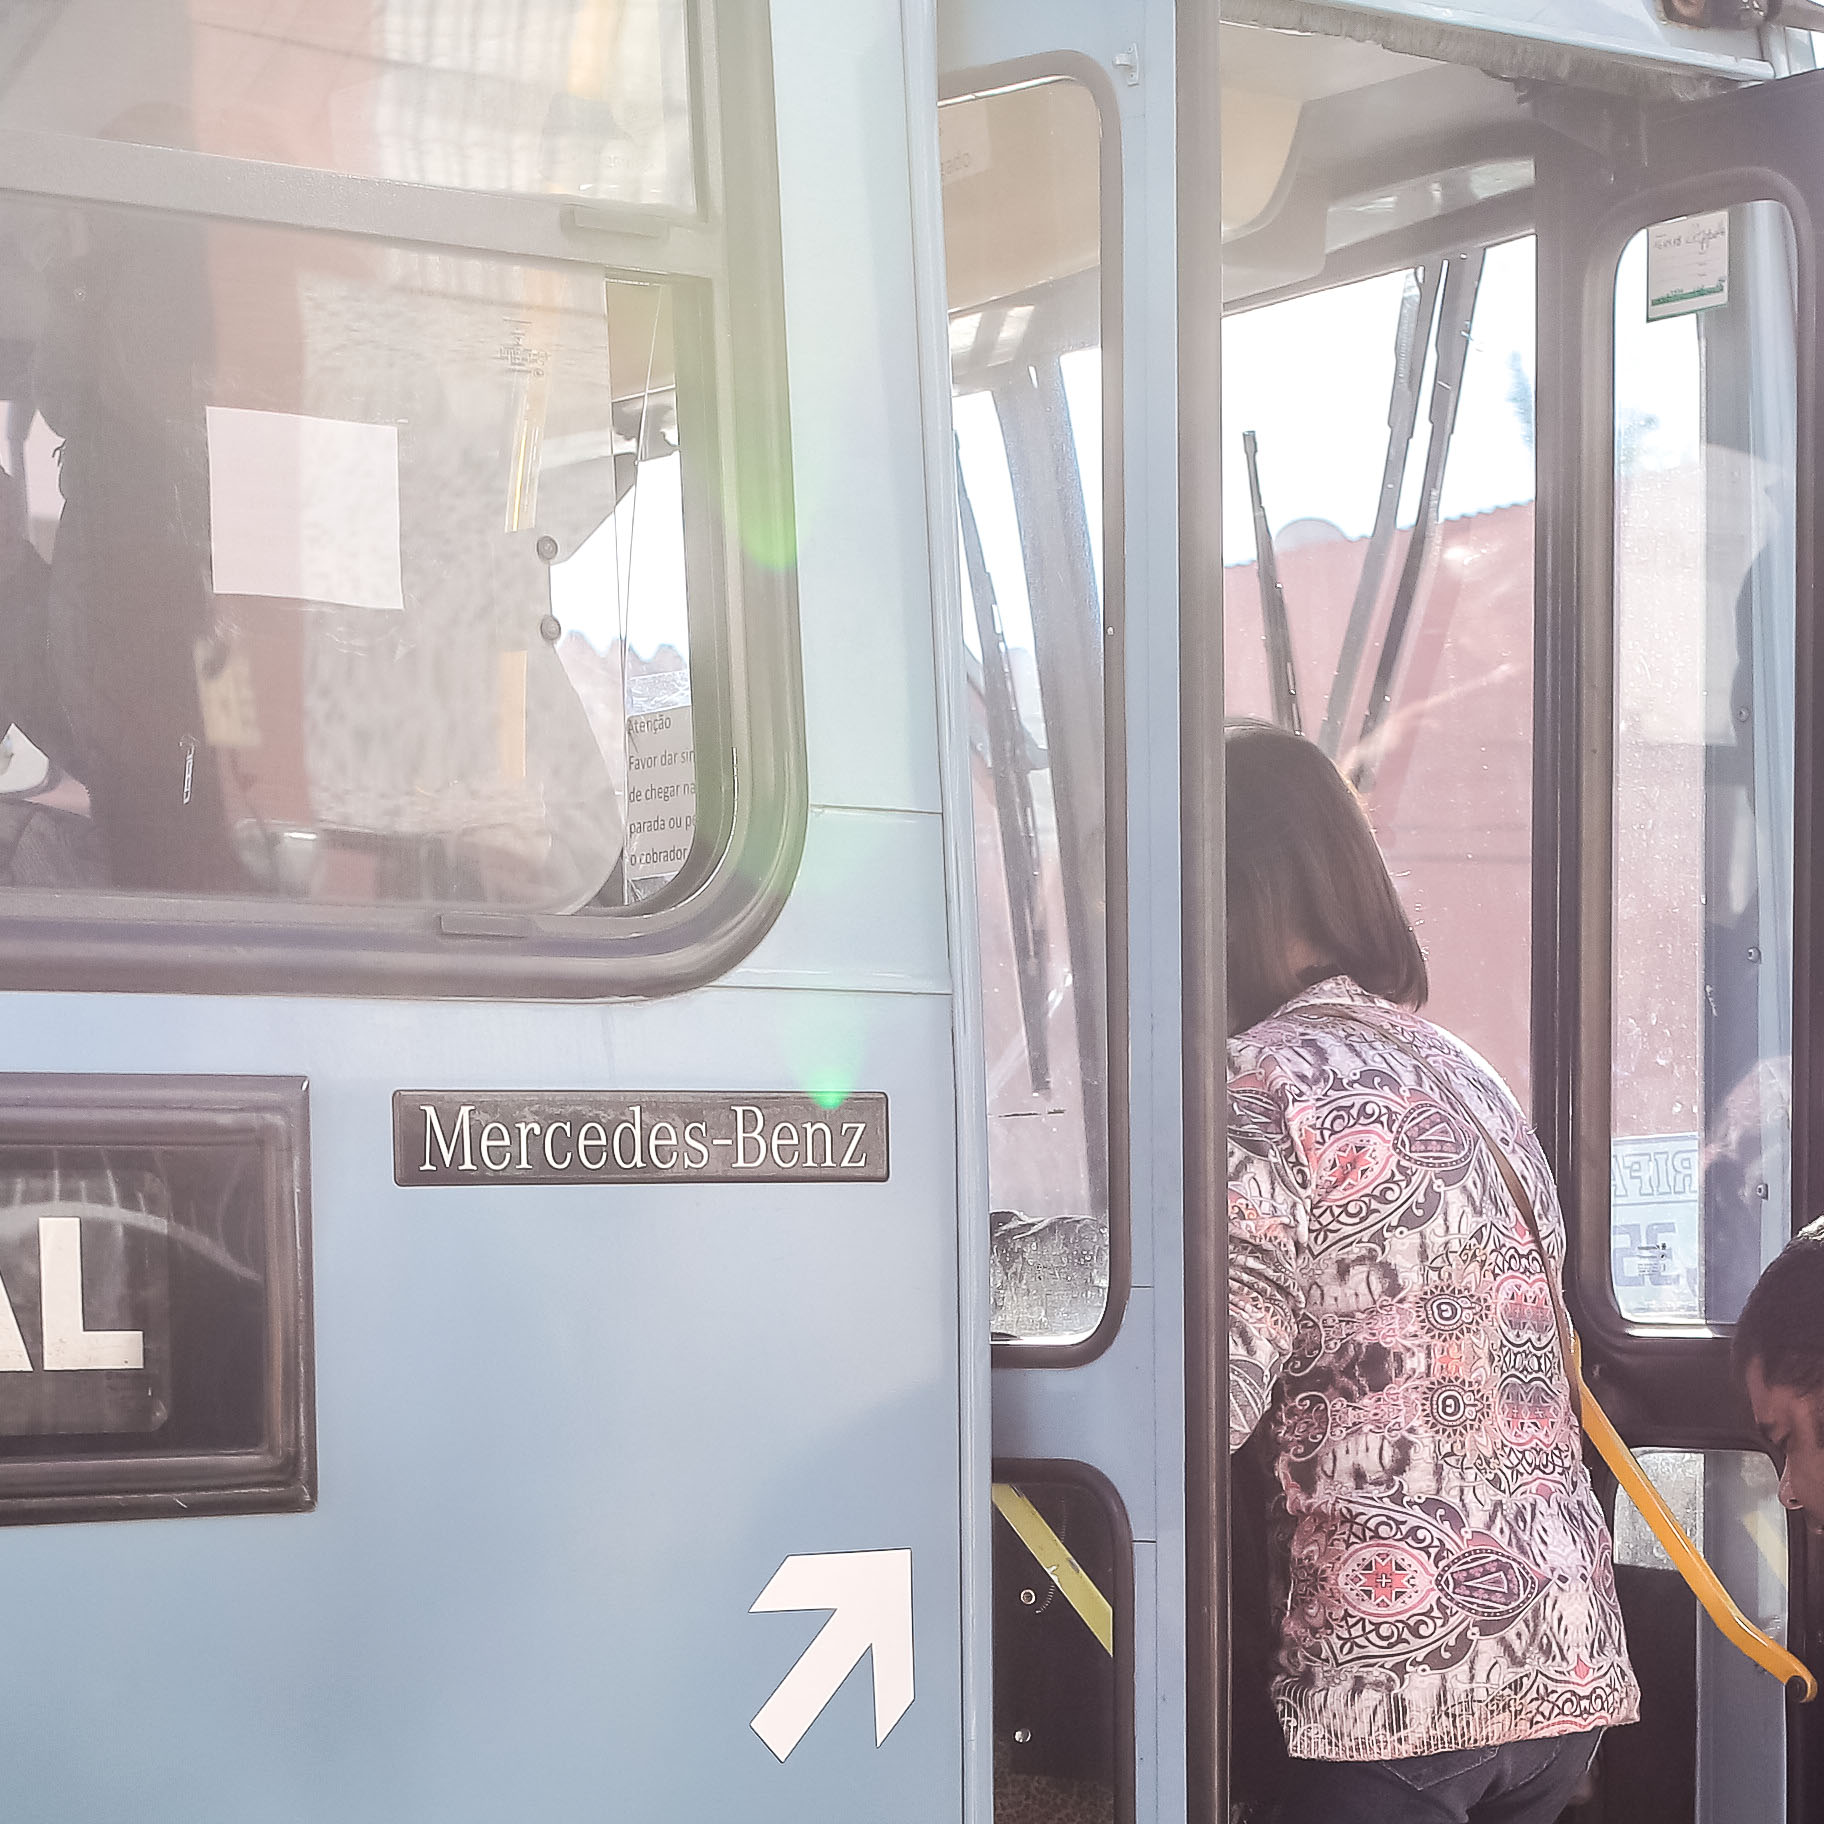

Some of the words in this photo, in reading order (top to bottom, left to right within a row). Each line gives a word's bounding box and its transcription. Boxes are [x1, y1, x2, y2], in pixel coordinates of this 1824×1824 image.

[627, 714, 672, 735] Atenção
[629, 755, 658, 771] Favor
[660, 750, 678, 767] dar
[629, 786, 642, 803] de
[645, 782, 681, 802] chegar
[629, 815, 666, 836] parada
[668, 815, 682, 830] ou
[630, 853, 637, 867] o
[639, 846, 688, 866] cobrador
[418, 1104, 868, 1172] Mercedes-Benz
